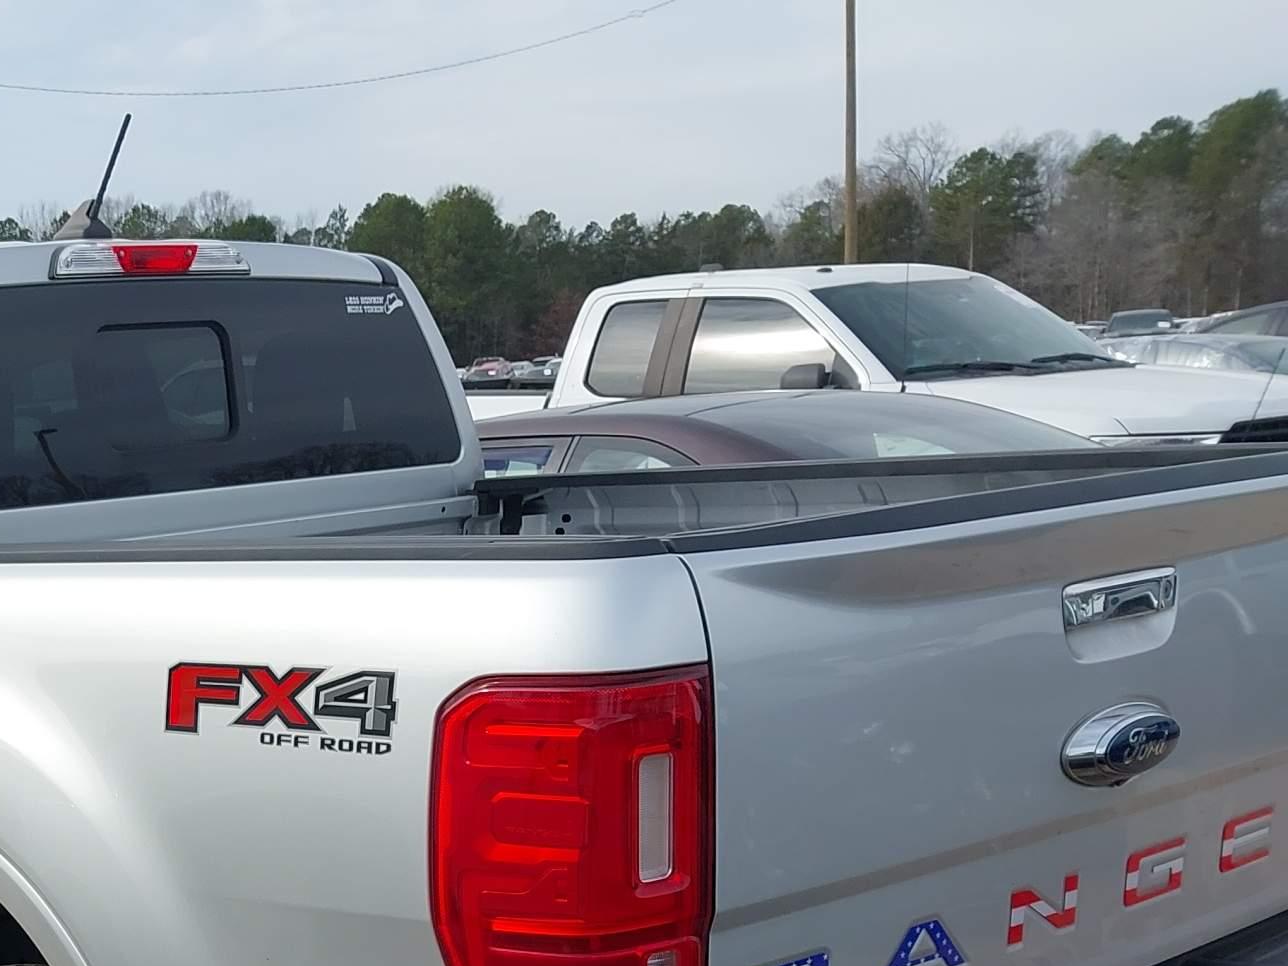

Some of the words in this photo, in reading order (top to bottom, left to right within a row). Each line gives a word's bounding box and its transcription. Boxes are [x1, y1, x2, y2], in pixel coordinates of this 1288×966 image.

[165, 661, 399, 739] FX4
[259, 731, 310, 749] OFF
[319, 735, 393, 756] ROAD
[1123, 724, 1170, 765] Ford
